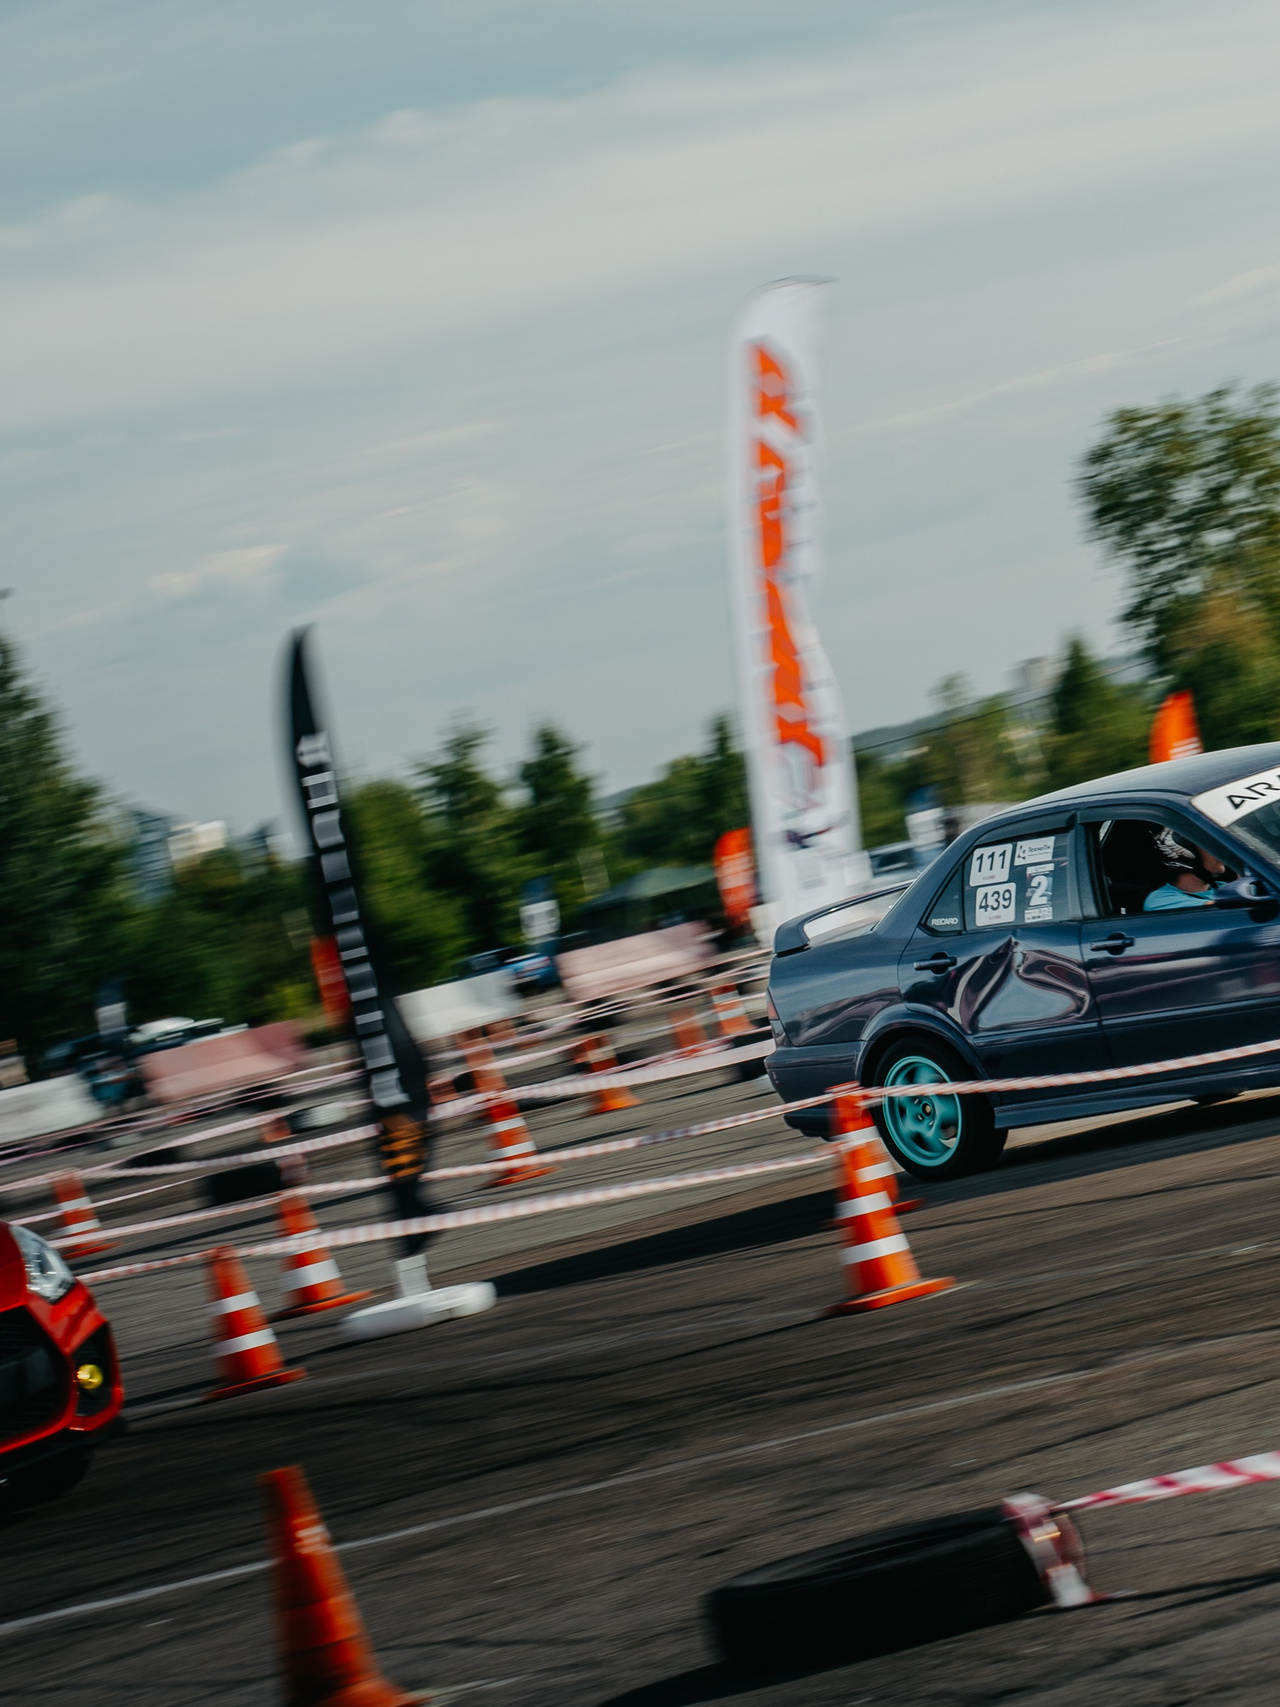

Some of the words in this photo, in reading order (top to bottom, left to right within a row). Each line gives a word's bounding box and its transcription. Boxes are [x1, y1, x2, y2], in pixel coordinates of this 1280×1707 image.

[976, 849, 1007, 873] 111
[979, 889, 1012, 912] 439
[1029, 875, 1048, 906] 2
[931, 917, 958, 925] RECARO
